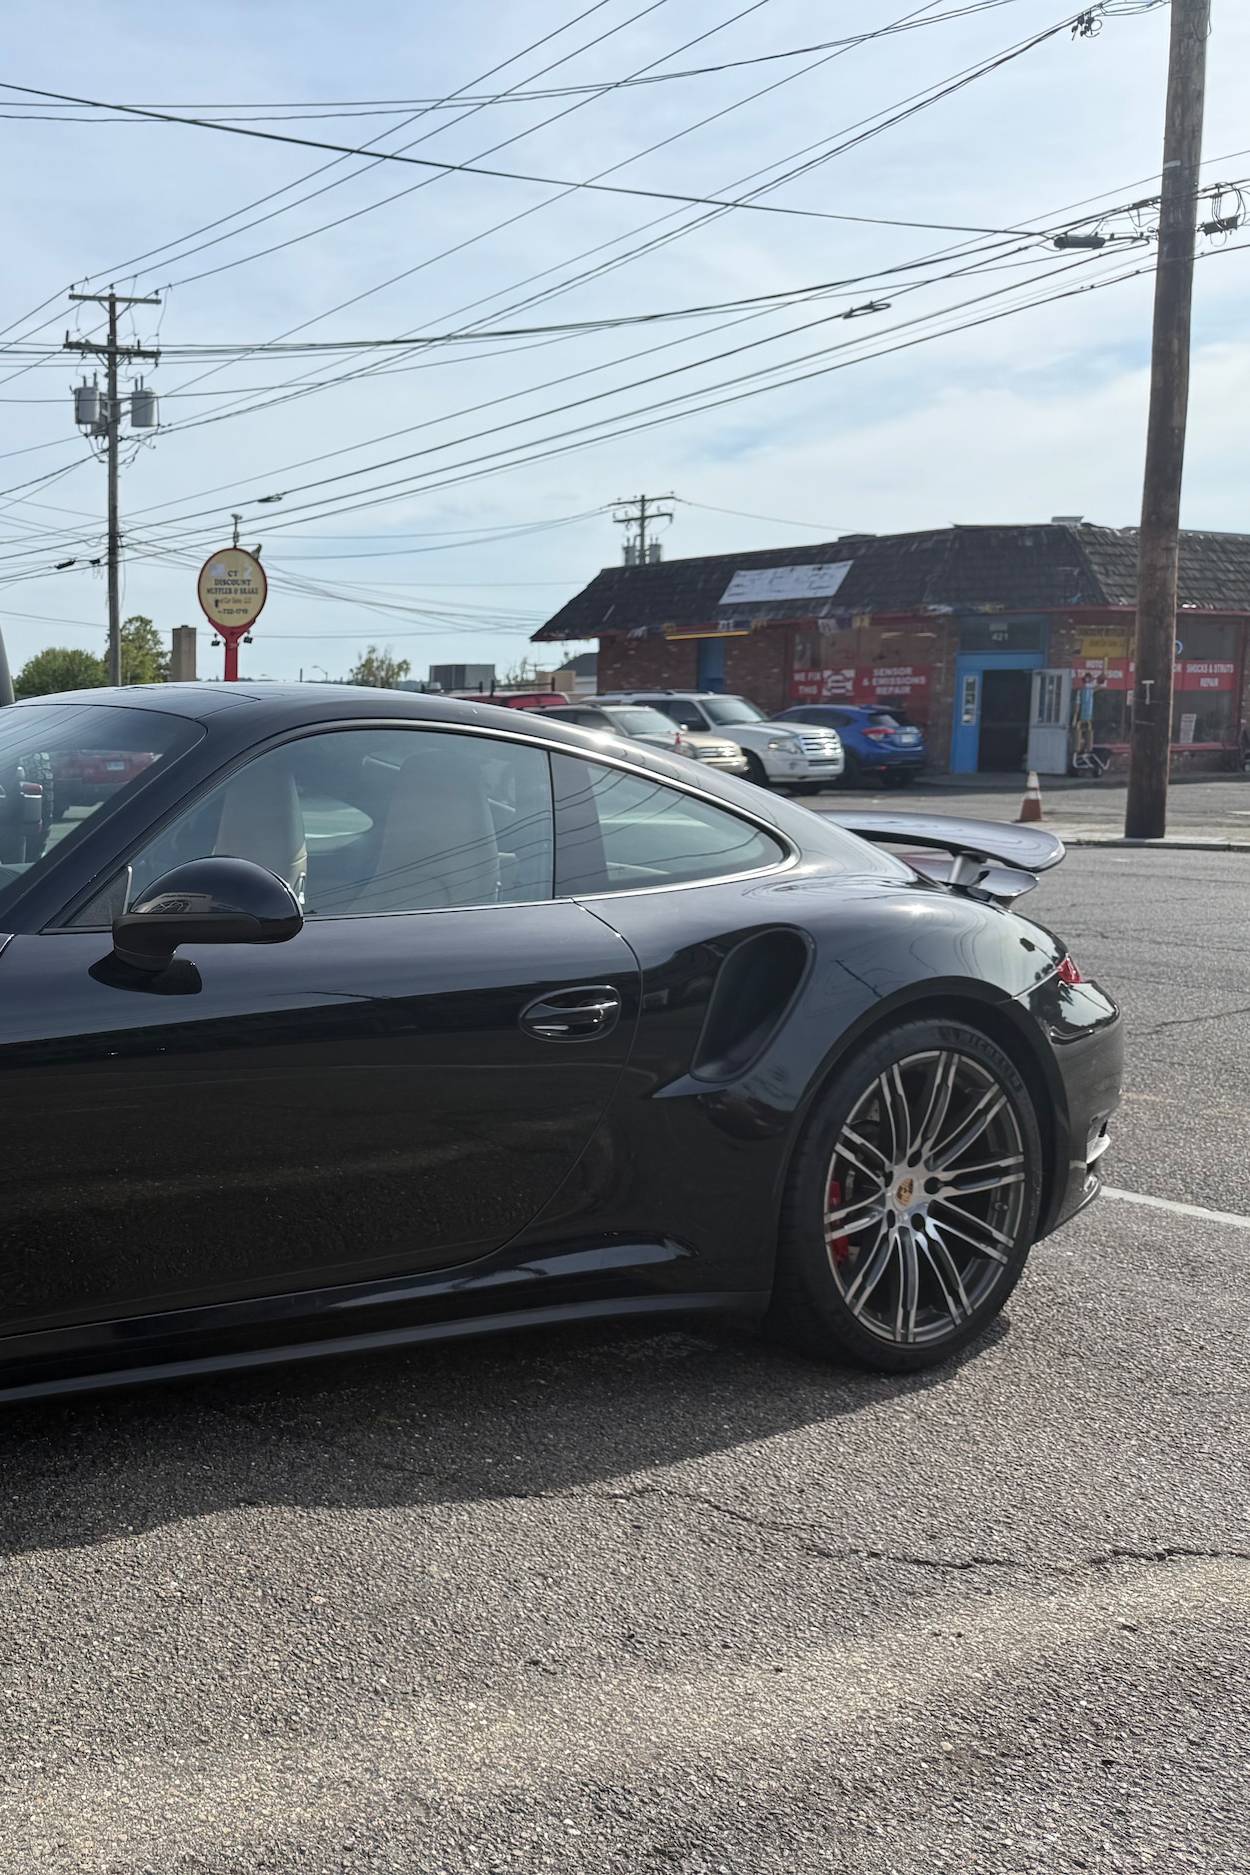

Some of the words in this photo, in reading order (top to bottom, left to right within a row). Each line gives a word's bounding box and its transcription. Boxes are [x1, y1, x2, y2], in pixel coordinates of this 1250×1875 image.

[227, 570, 239, 578] CT
[992, 632, 1009, 641] 421
[872, 667, 913, 677] SENSOR
[1186, 663, 1208, 673] SHOCKS
[793, 672, 807, 681] WE
[807, 671, 821, 681] FIX
[862, 677, 870, 686] &
[871, 676, 926, 687] EMISSIONS
[798, 685, 818, 694] THIS
[875, 686, 912, 695] REPAIR
